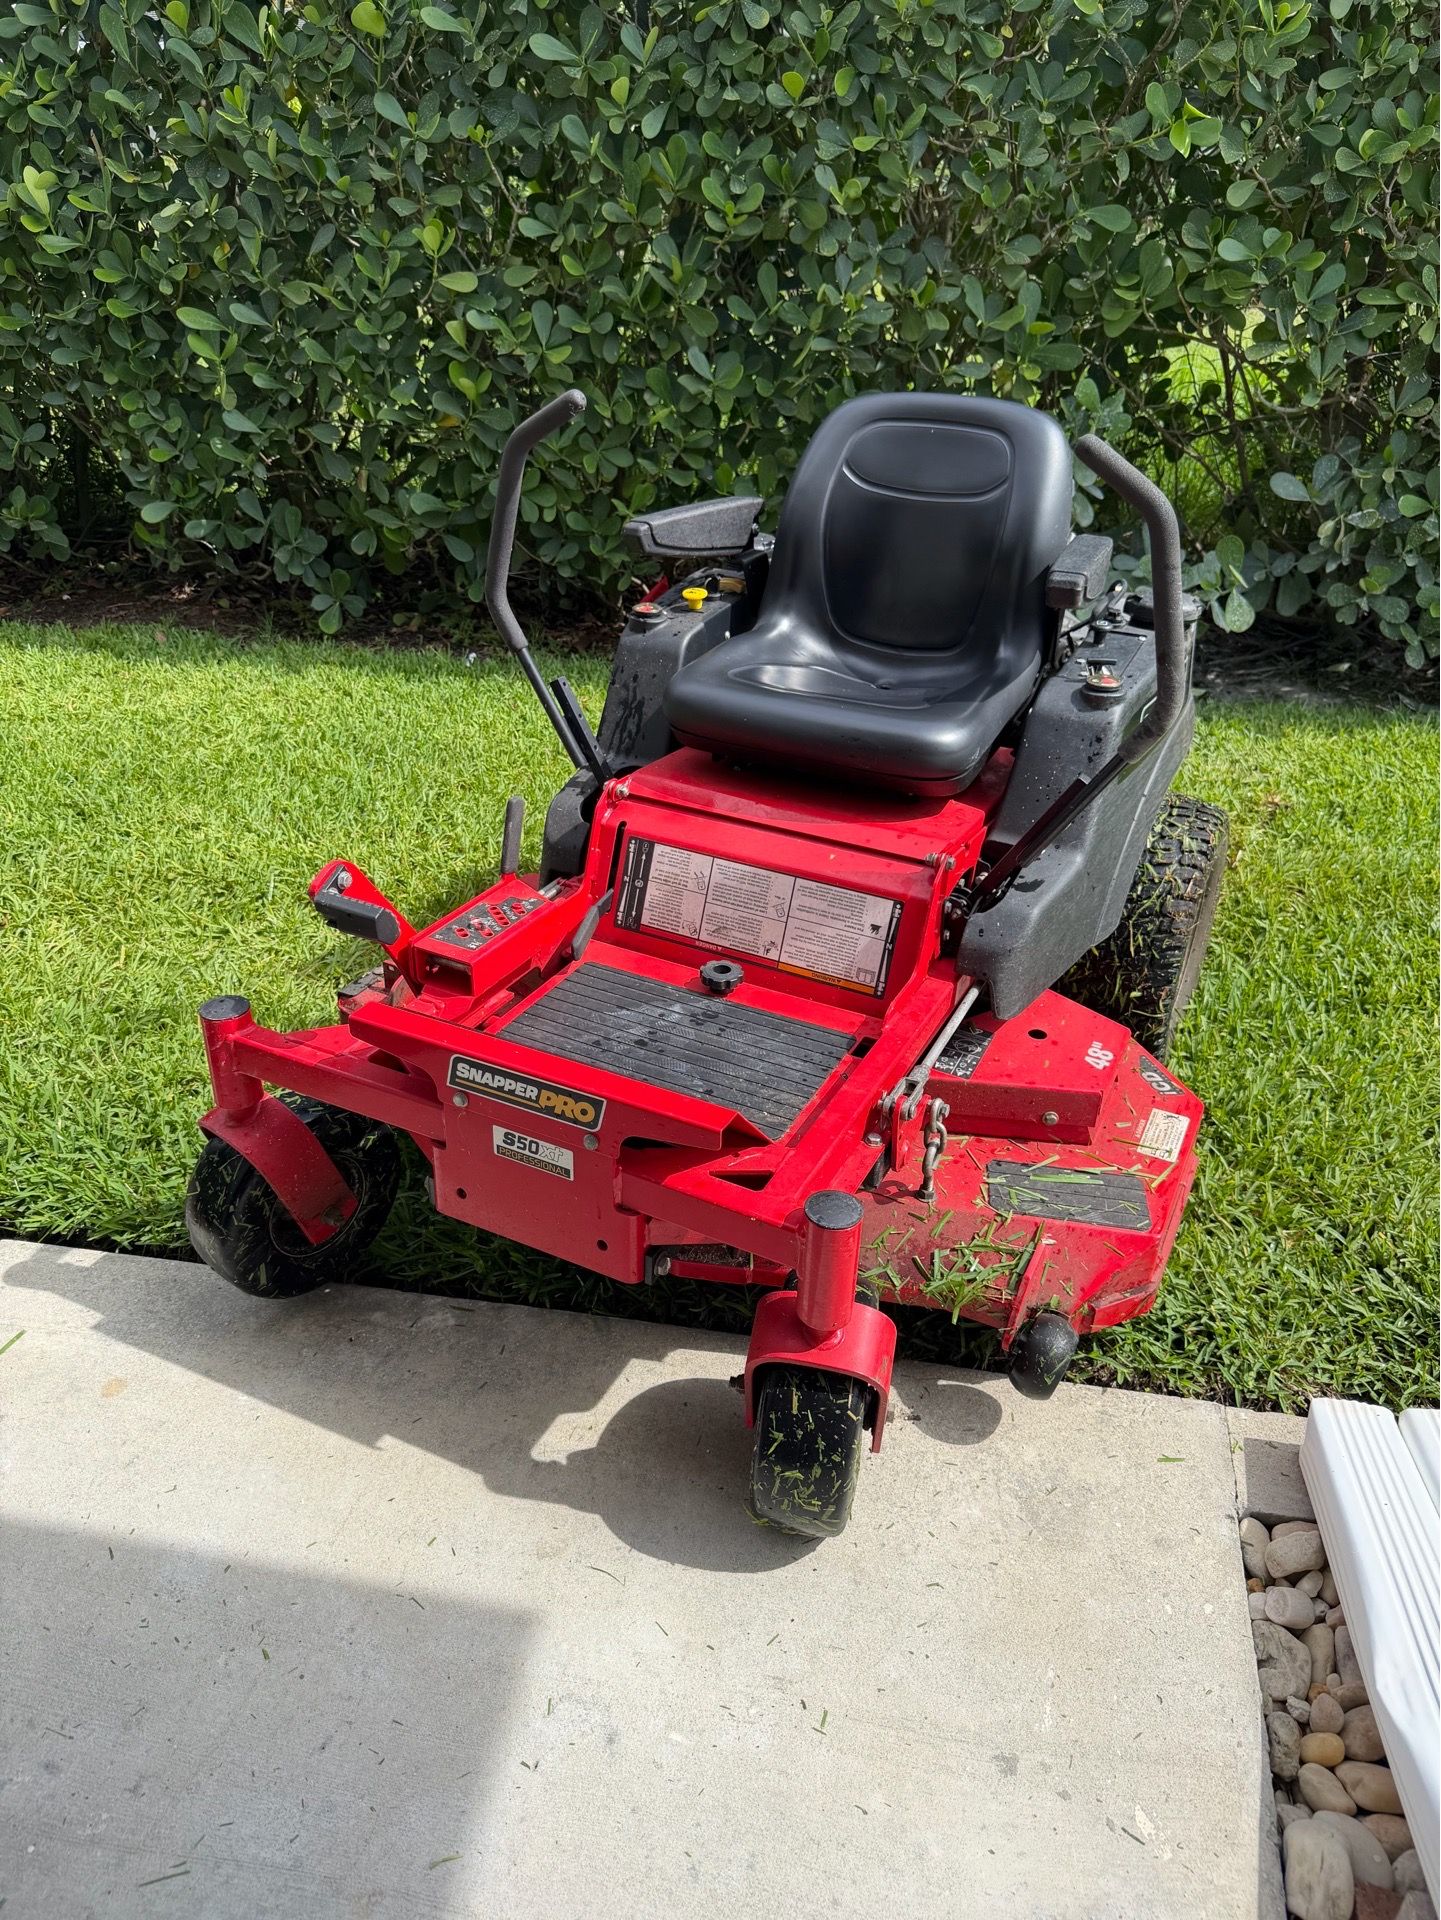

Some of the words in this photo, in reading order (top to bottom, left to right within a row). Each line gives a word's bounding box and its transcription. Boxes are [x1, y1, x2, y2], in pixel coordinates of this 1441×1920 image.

[455, 1062, 539, 1101] SNAPPER
[538, 1089, 596, 1123] PRO
[498, 1148, 568, 1177] PROFESSIONAL
